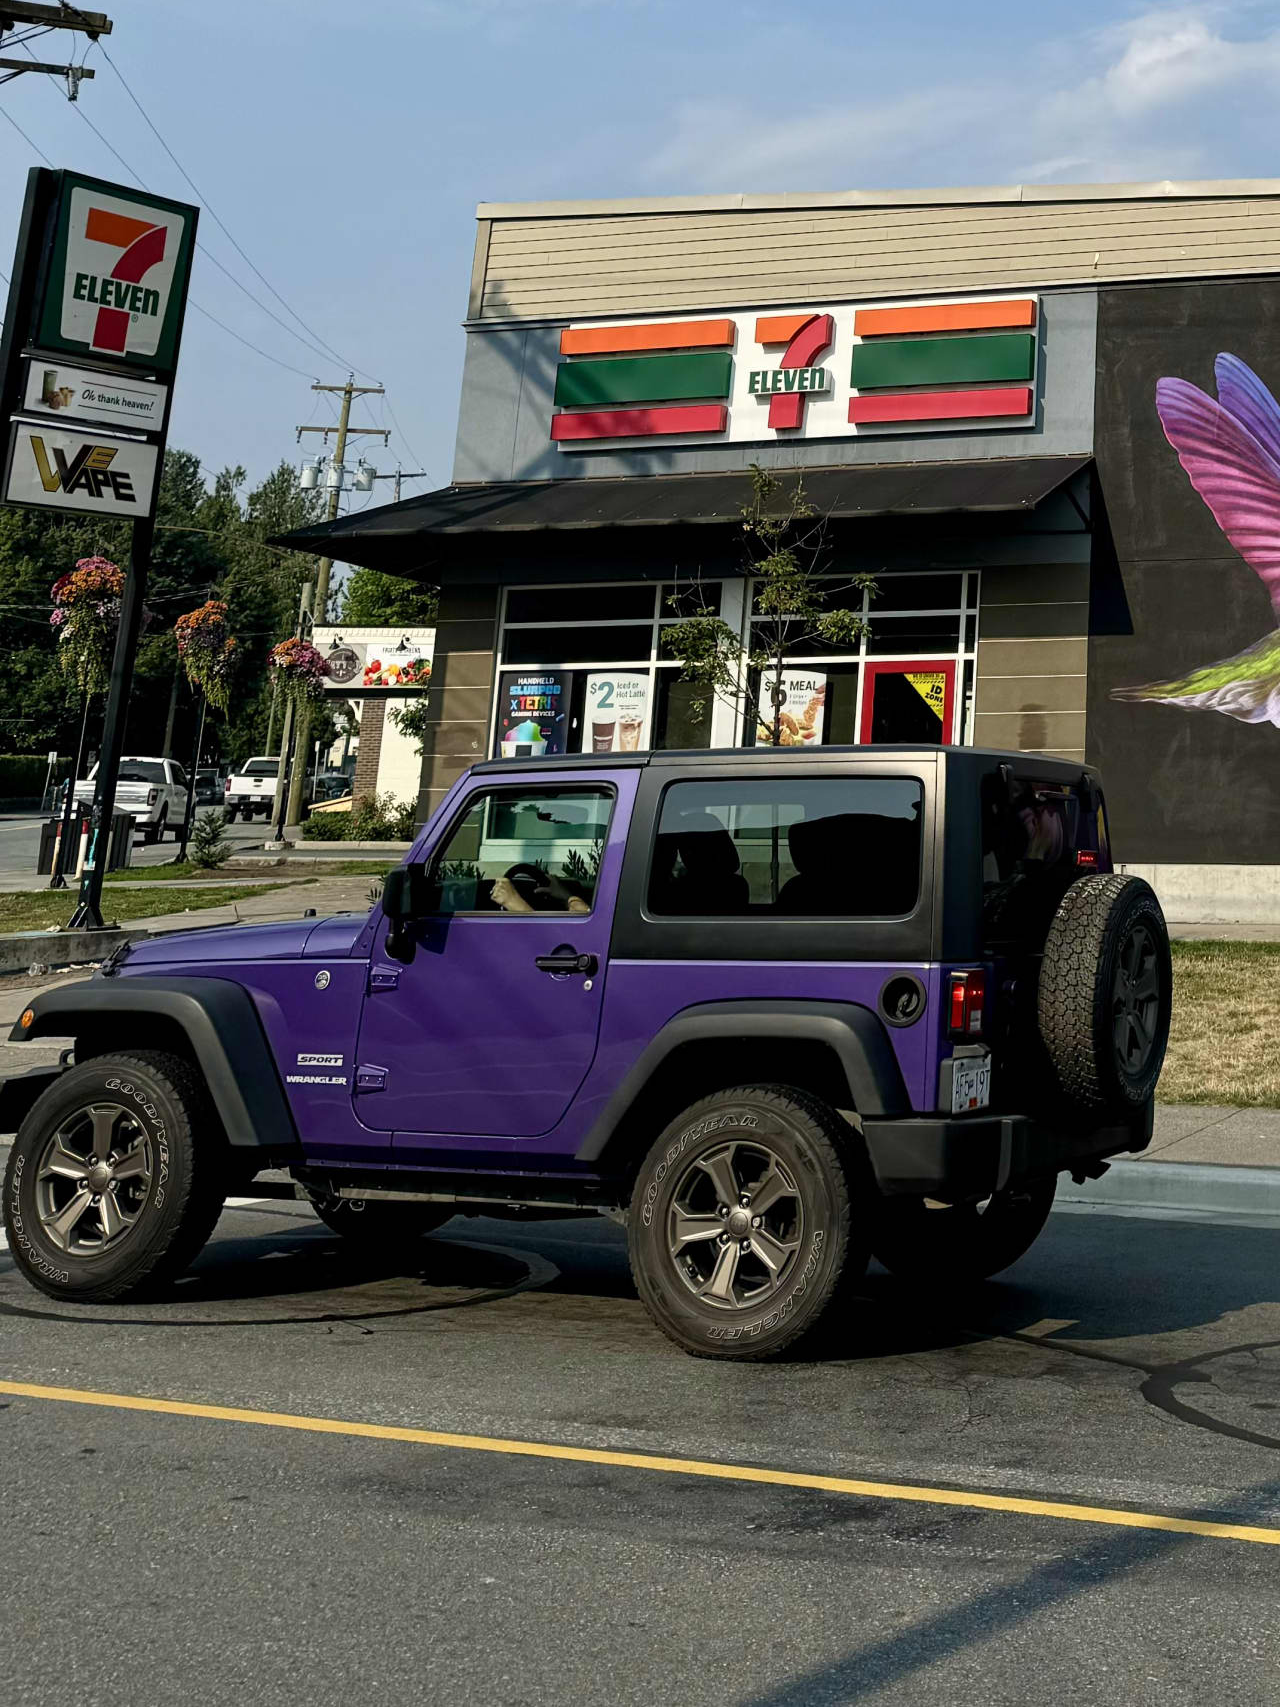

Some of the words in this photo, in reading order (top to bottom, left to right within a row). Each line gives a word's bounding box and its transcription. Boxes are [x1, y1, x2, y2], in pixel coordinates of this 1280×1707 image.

[85, 207, 168, 352] 7
[81, 389, 96, 401] Oh
[97, 393, 121, 406] thank
[121, 397, 155, 412] heaven!
[755, 314, 835, 429] 7
[519, 696, 558, 710] TETRIS
[789, 680, 817, 691] MEAL
[930, 684, 942, 695] ID
[286, 1075, 347, 1085] WRANGLER
[300, 1055, 342, 1064] SPORT
[105, 1078, 169, 1209] GOODYEAR
[641, 1114, 760, 1227] GOODYEAR
[8, 1154, 70, 1284] WRANGLER
[707, 1231, 825, 1340] WRANGLER
